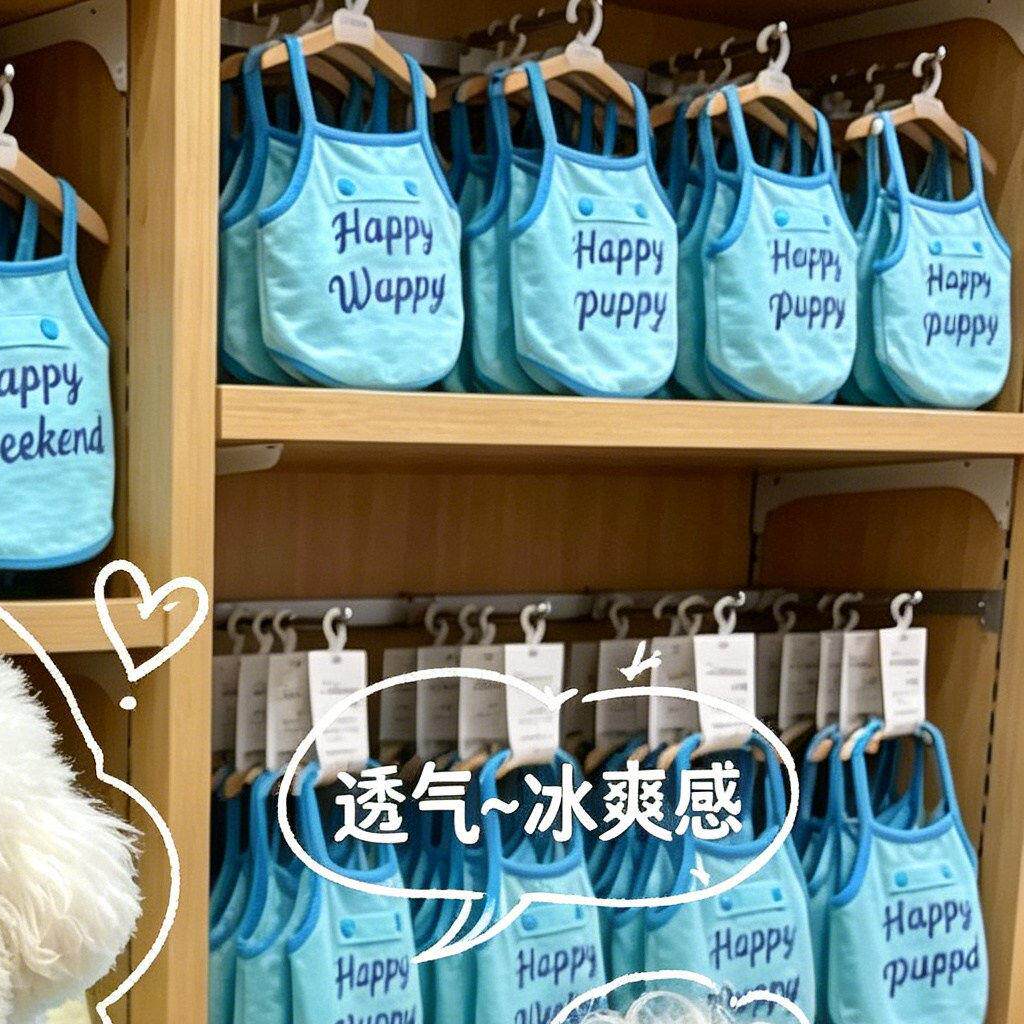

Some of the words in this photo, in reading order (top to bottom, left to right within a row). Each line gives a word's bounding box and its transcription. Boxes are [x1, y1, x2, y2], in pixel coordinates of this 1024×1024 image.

[331, 207, 434, 256] Happy
[573, 230, 665, 275] Happy
[883, 900, 971, 941] Happy
[516, 945, 596, 988] Happy
[709, 925, 796, 969] Happy
[335, 954, 409, 999] Happy
